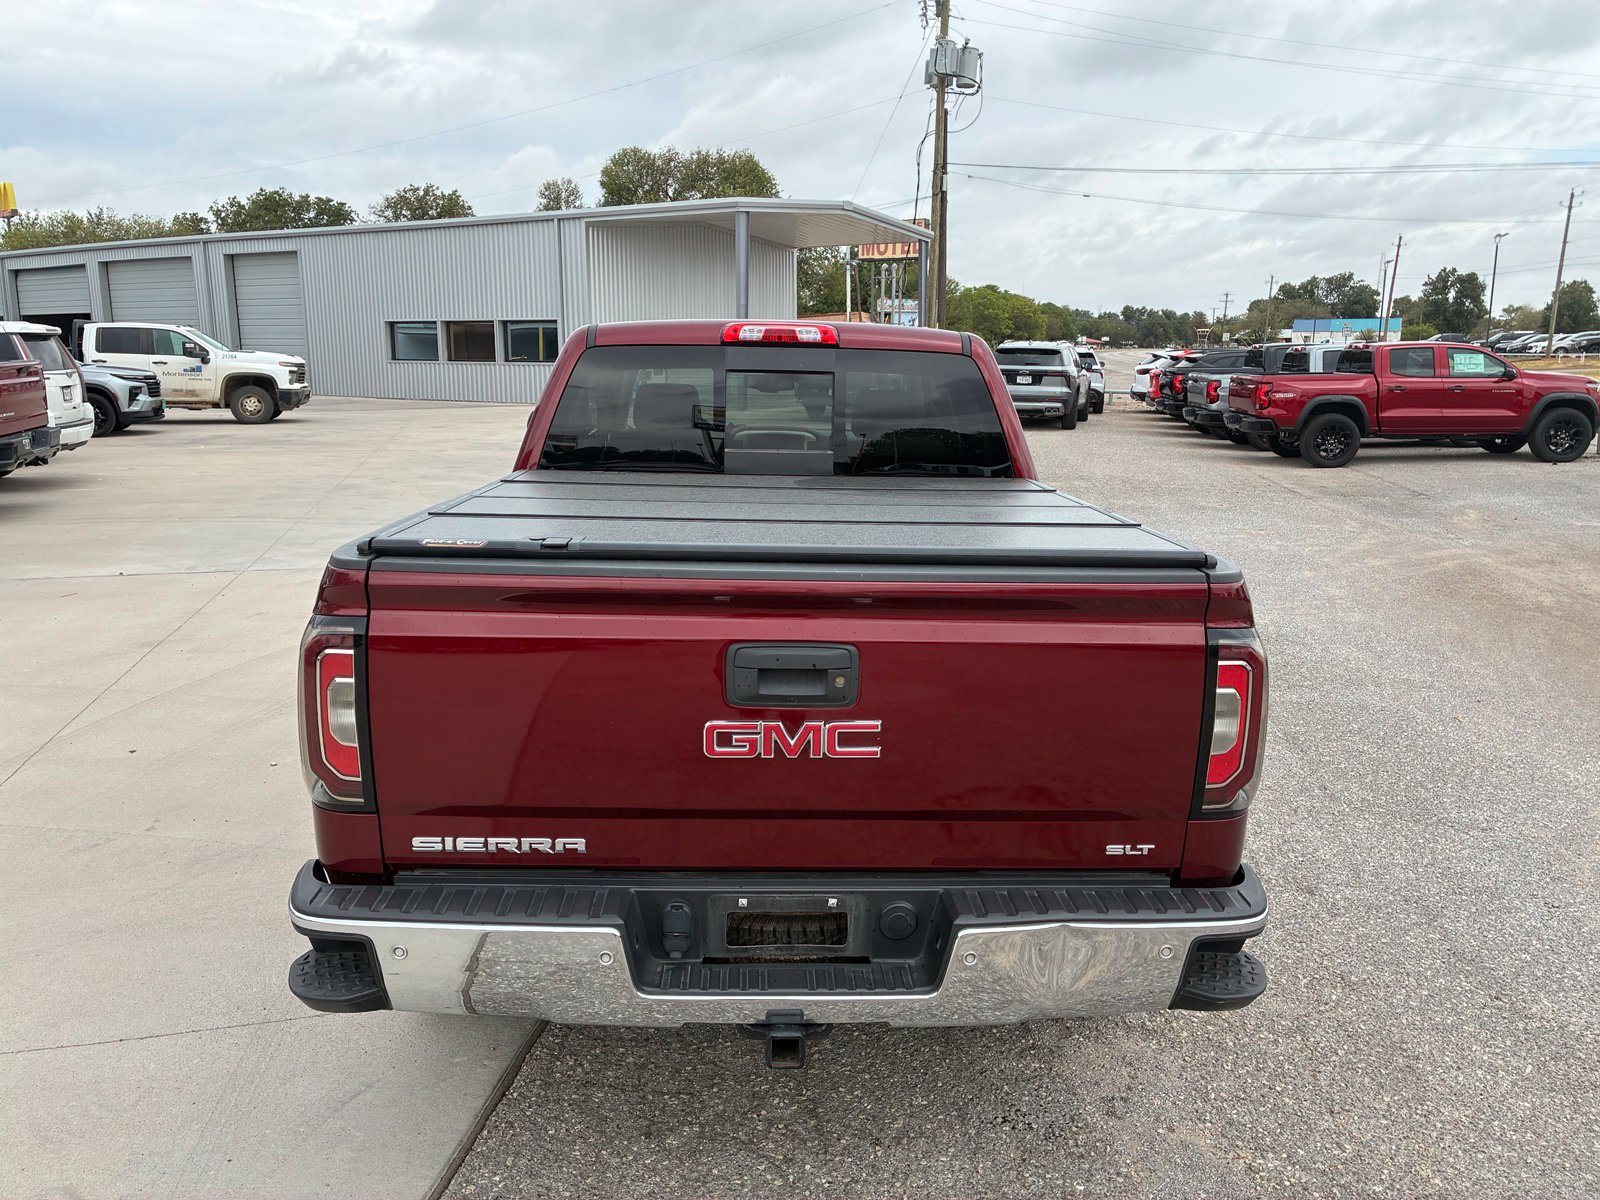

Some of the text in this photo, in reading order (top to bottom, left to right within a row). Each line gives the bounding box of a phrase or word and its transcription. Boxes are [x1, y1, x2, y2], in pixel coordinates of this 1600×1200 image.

[703, 720, 882, 758] GMC
[412, 836, 587, 854] SIERRA
[1105, 844, 1156, 855] SLT
